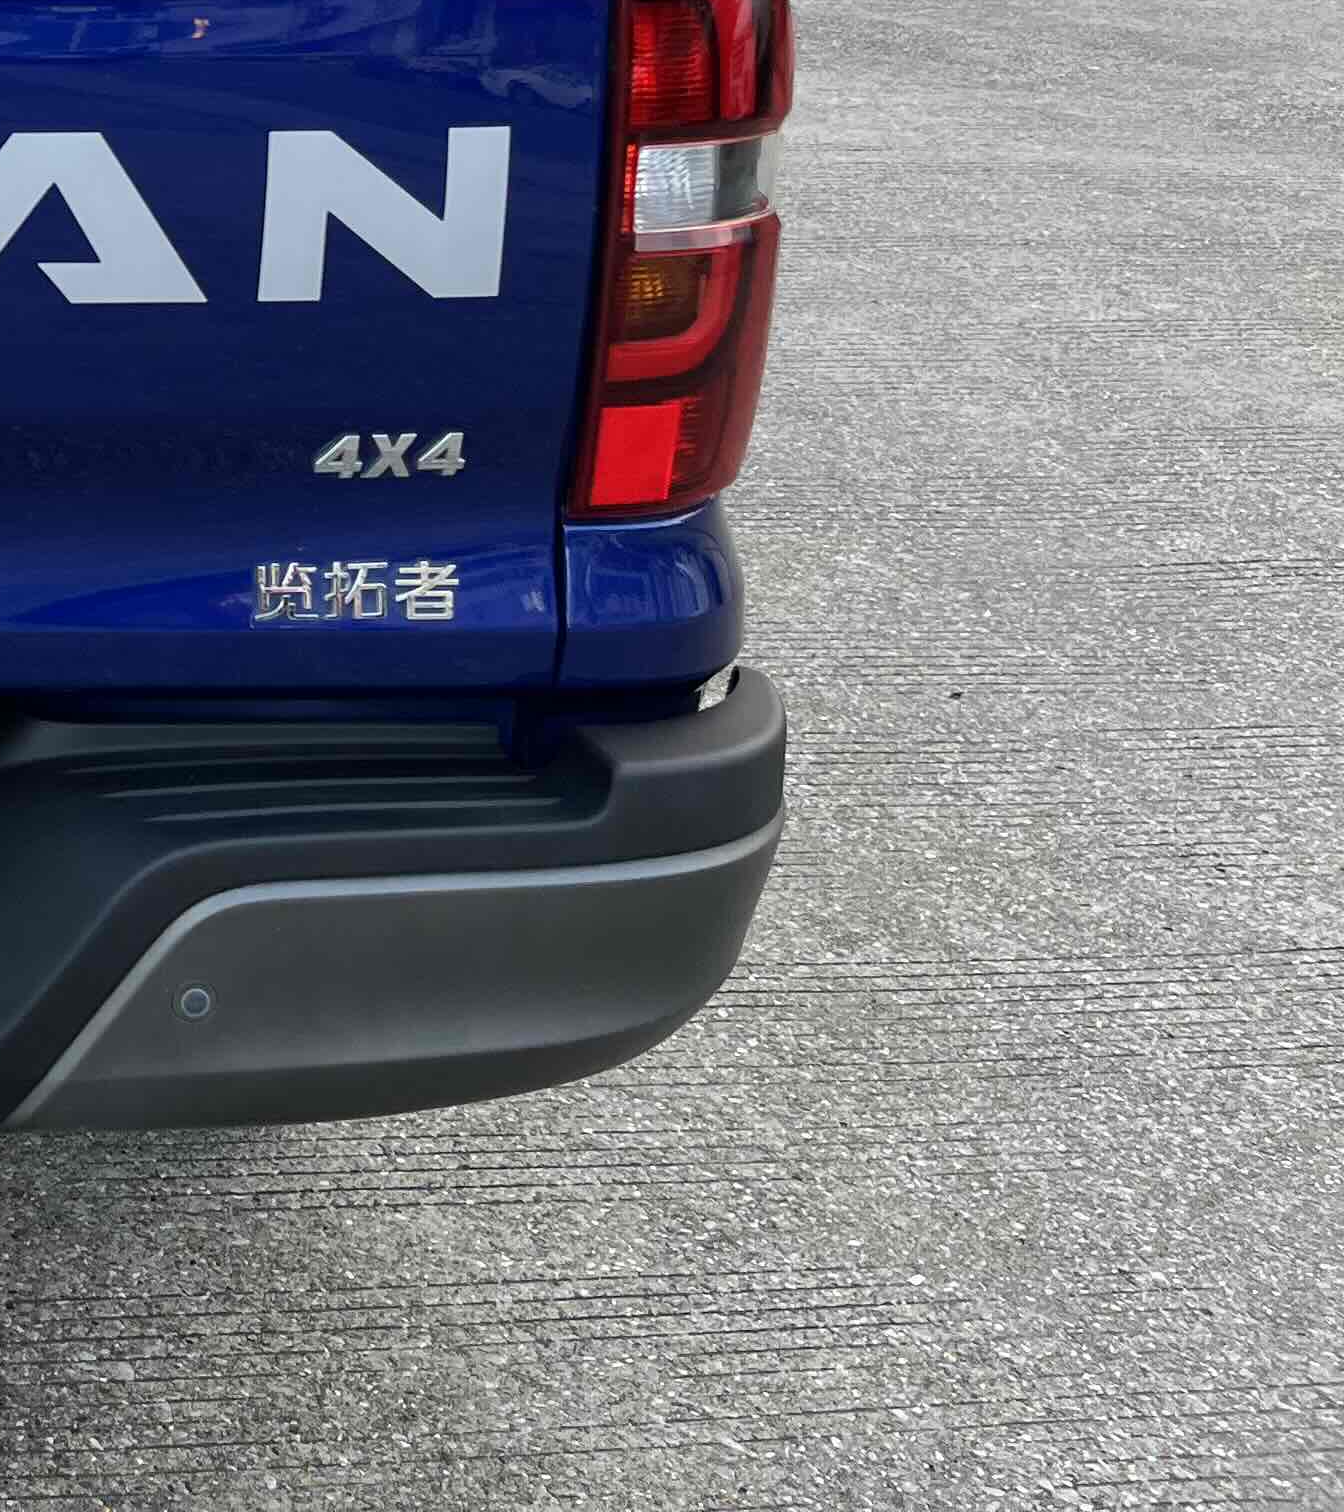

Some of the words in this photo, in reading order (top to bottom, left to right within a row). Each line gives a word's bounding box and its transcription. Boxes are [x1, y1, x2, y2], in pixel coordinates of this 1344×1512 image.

[313, 432, 466, 479] 4X4
[254, 561, 459, 621] 览拓者
